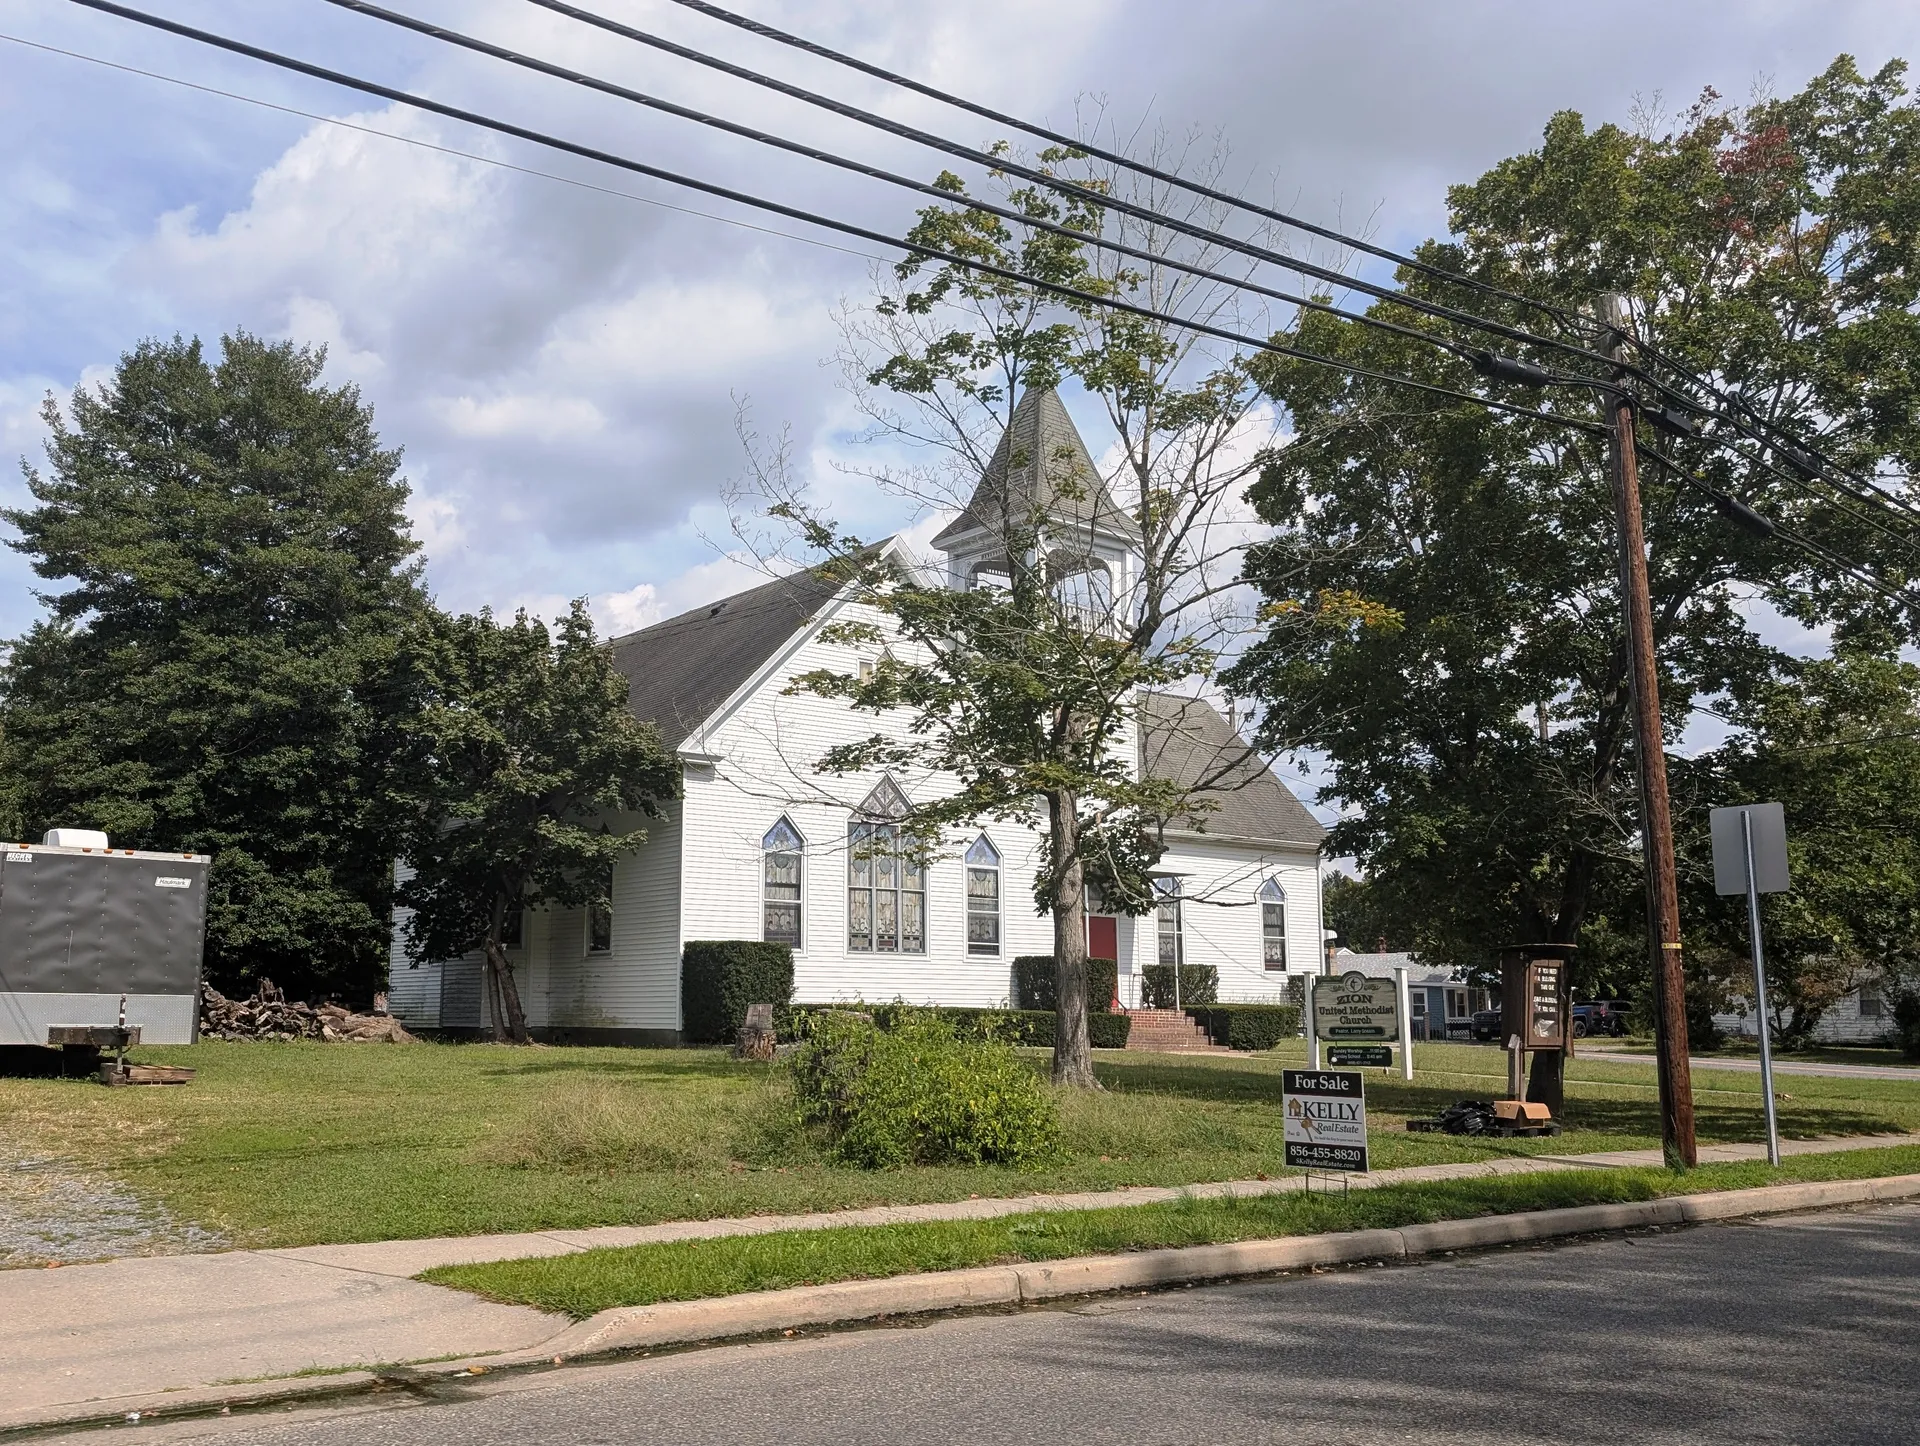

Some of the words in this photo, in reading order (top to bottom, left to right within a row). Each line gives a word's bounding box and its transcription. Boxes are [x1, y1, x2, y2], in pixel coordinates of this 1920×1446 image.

[1336, 993, 1374, 1005] ZION
[1318, 1006, 1348, 1015] United
[1349, 1005, 1395, 1015] Methodist
[1339, 1015, 1373, 1025] Church
[1294, 1074, 1318, 1089] For
[1319, 1075, 1350, 1091] Sale
[1302, 1100, 1360, 1121] KELLY
[1290, 1145, 1361, 1161] 856-455-8820
[1295, 1158, 1356, 1169] SKellyRealEstate.com
